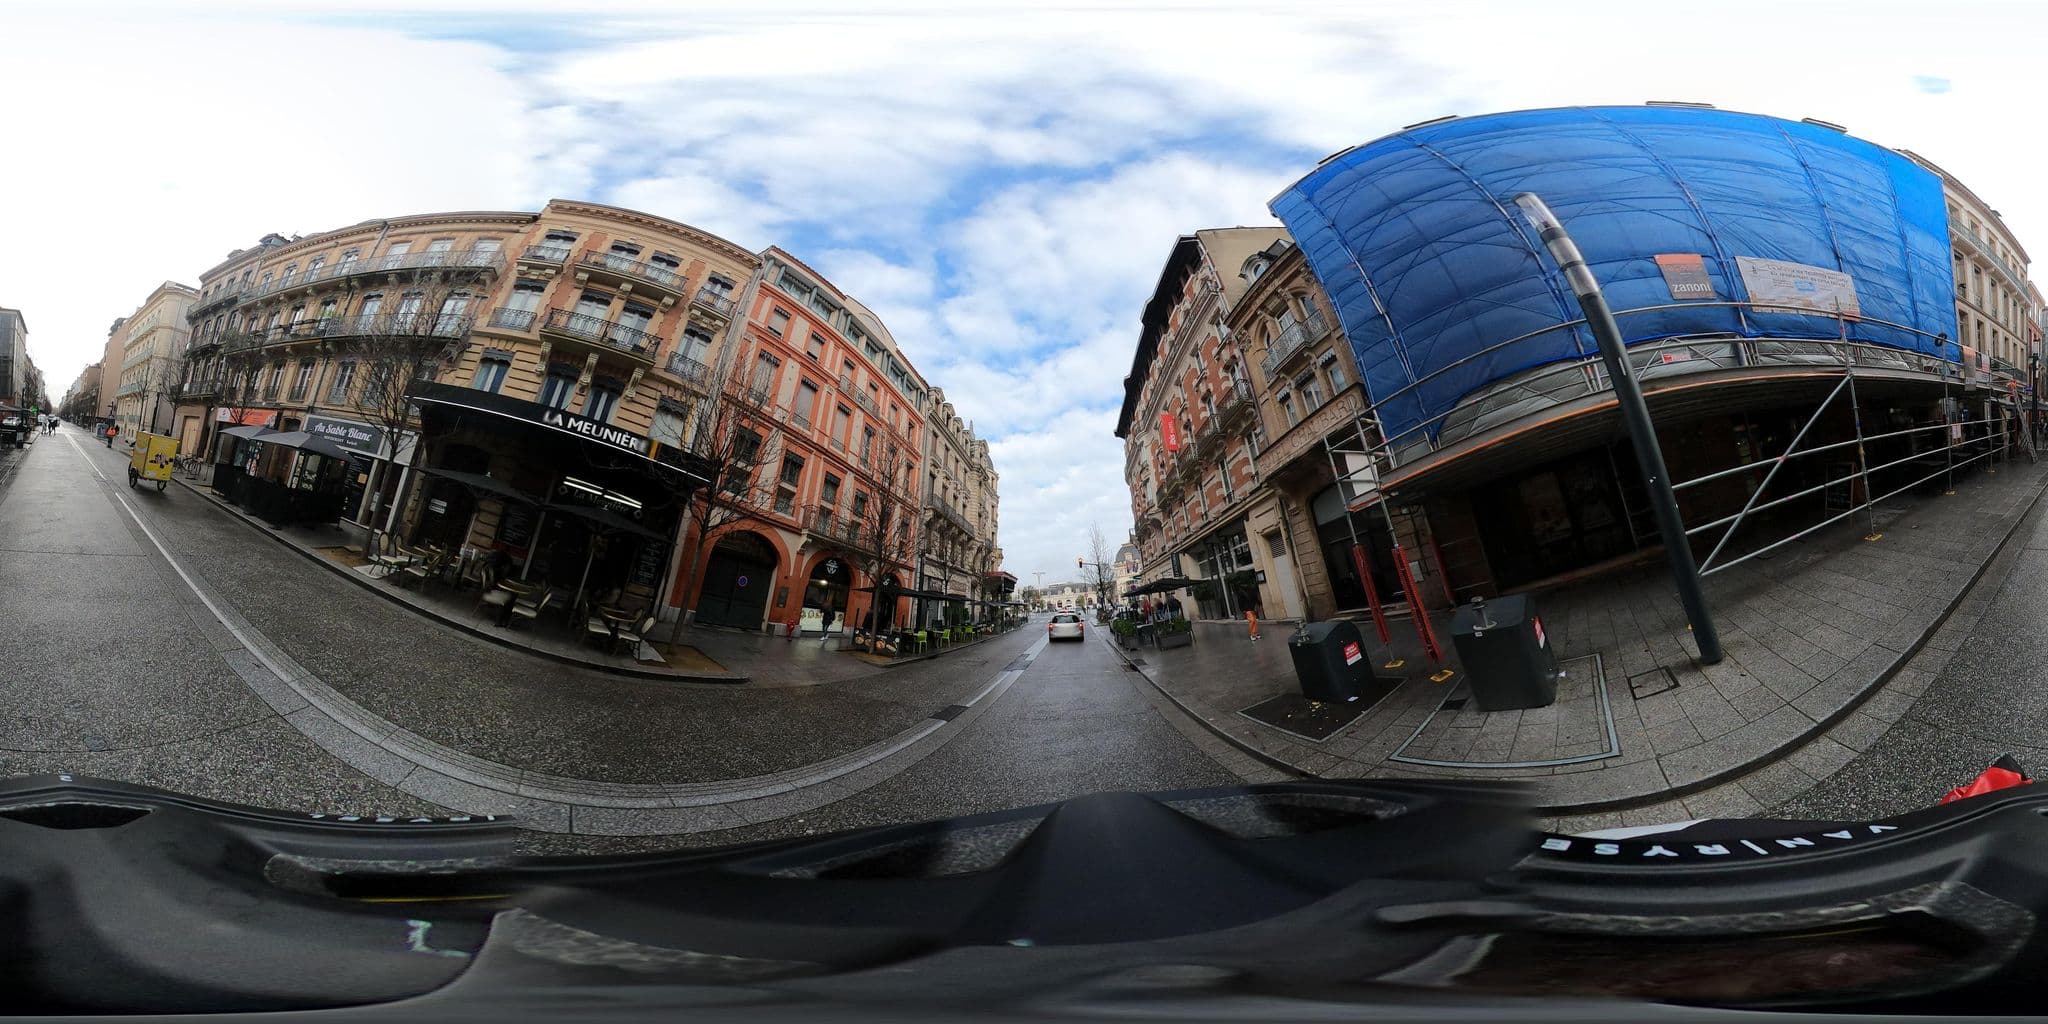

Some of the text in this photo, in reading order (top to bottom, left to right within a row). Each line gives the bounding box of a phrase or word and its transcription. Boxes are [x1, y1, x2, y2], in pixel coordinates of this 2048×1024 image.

[1672, 283, 1711, 292] zanoni
[542, 409, 563, 426] LA
[314, 422, 373, 441] Au Sable Blanc
